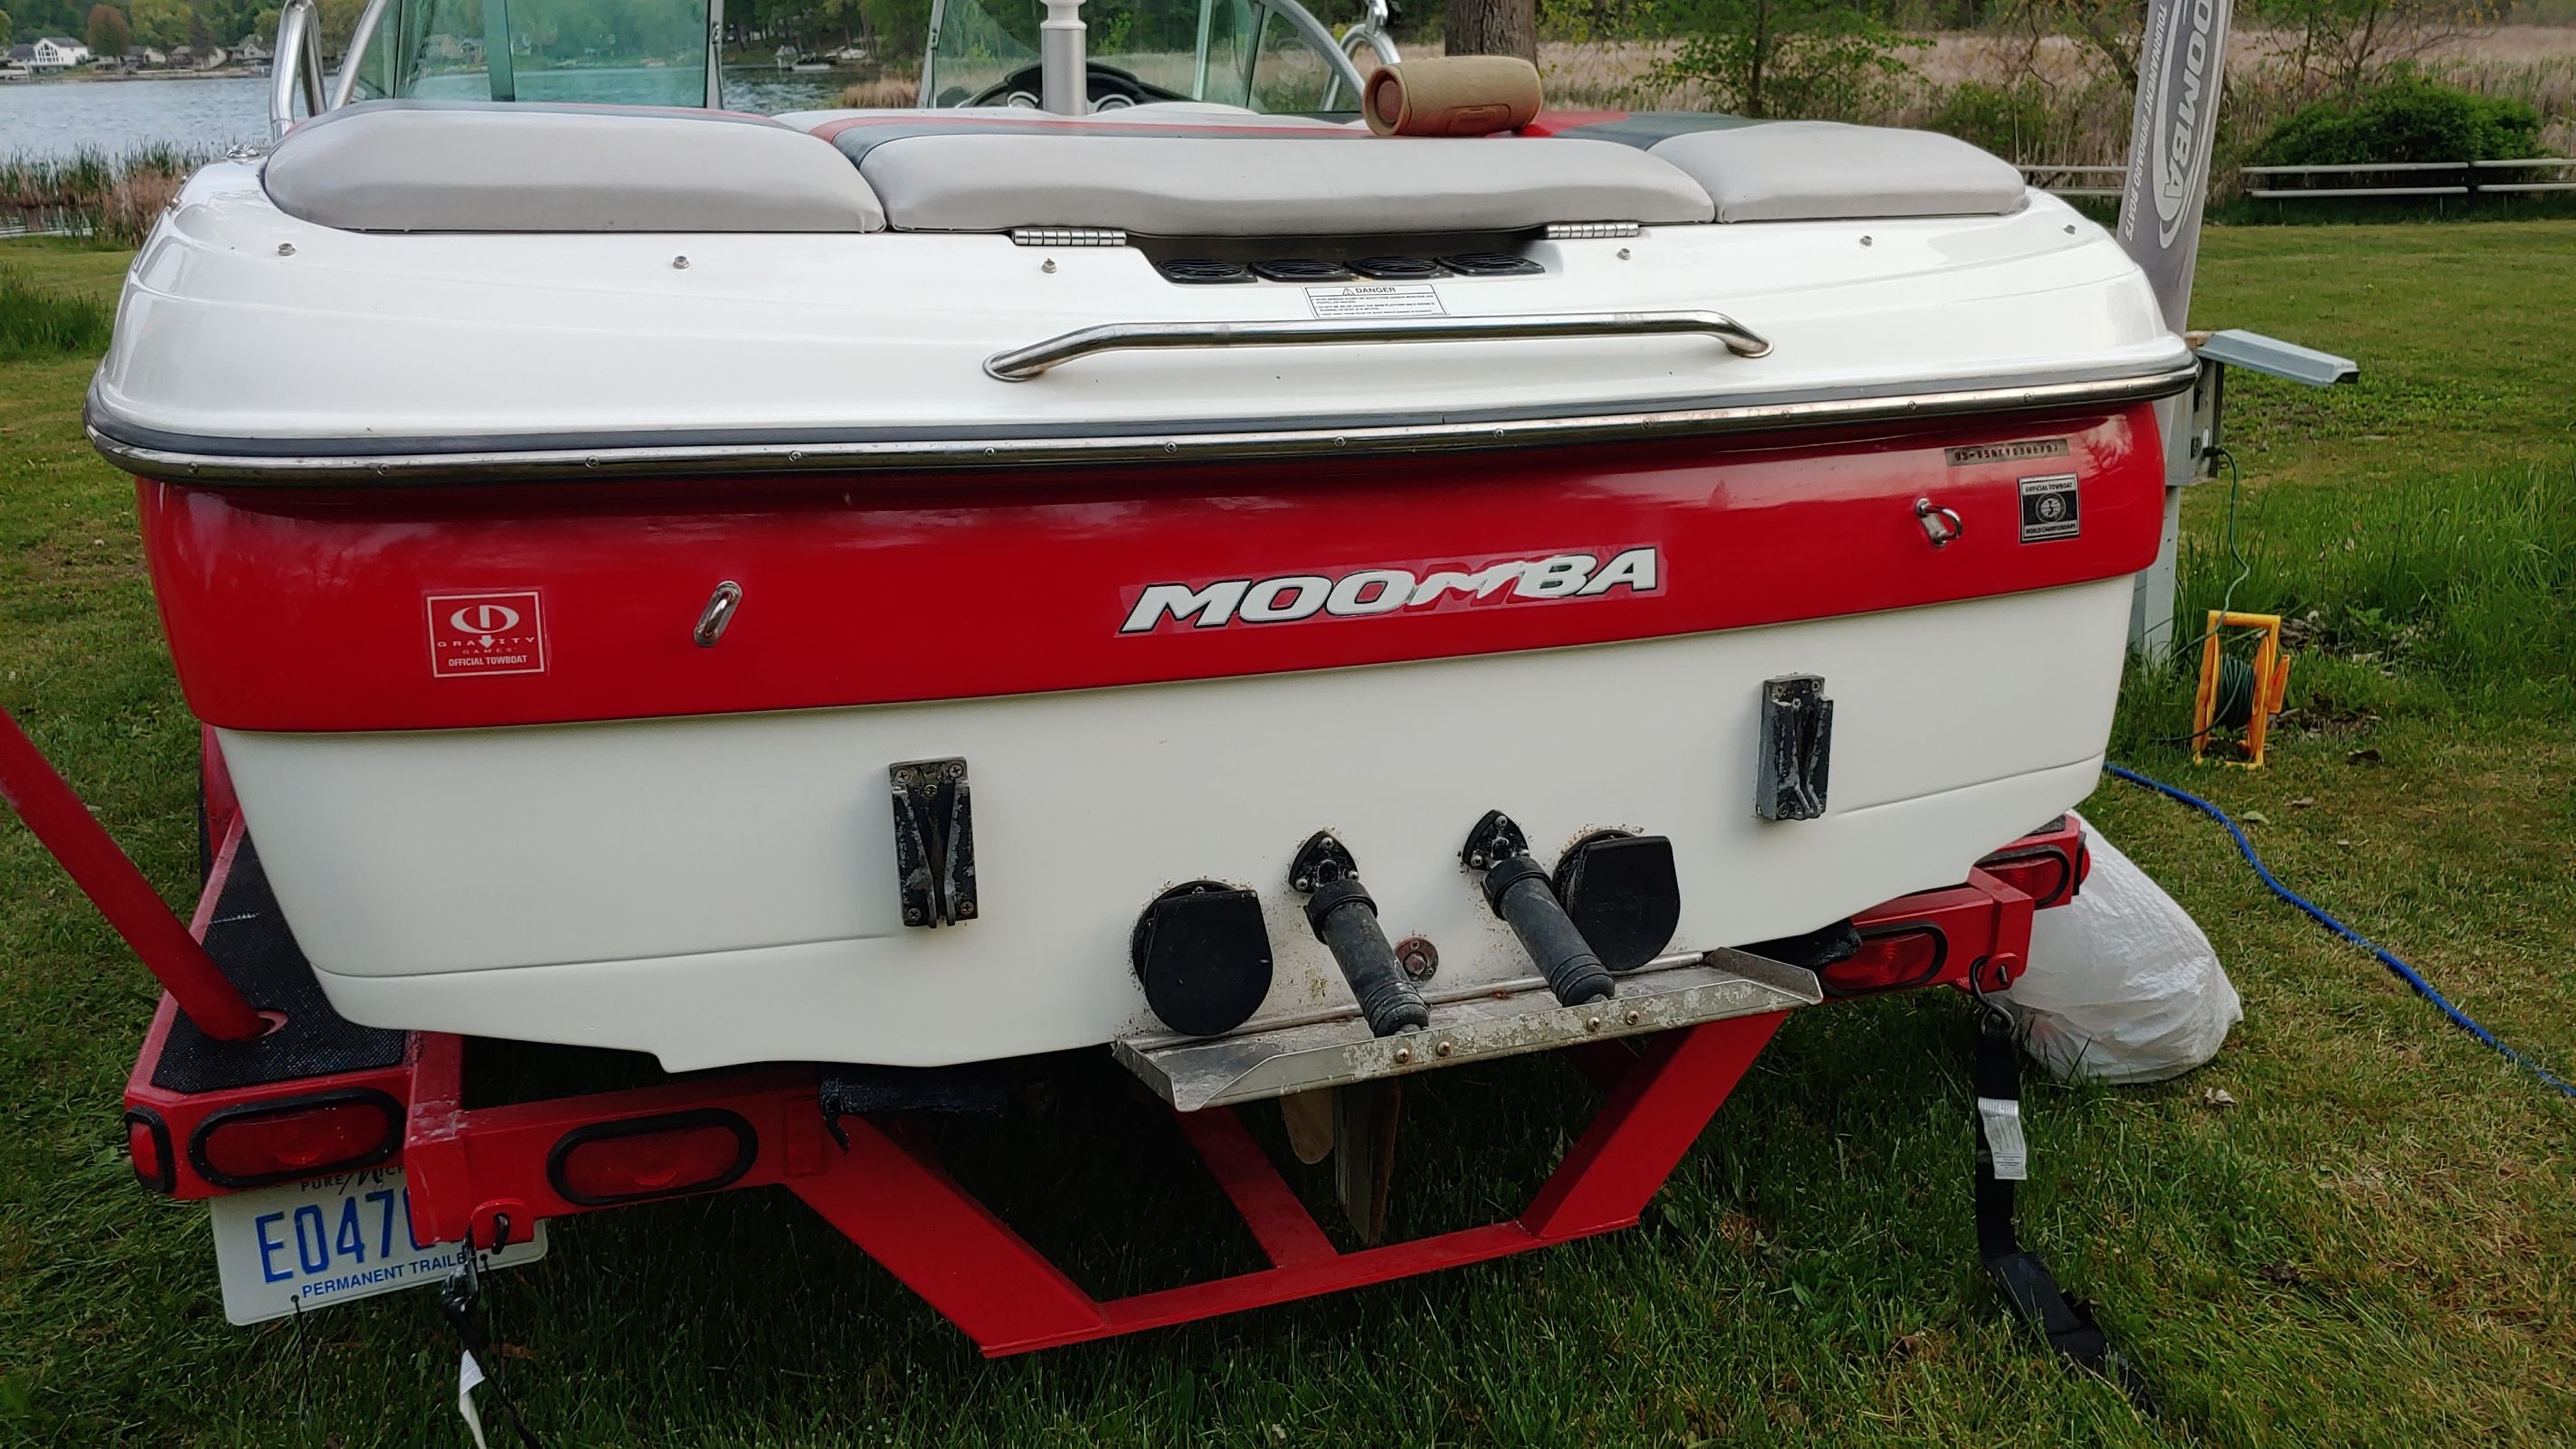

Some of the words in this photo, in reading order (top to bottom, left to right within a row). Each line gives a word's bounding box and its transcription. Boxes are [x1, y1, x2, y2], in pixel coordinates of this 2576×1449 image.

[2142, 3, 2168, 117] TOURNAMENT
[2164, 0, 2213, 198] OOMBA
[2133, 115, 2151, 188] INBOARD
[2125, 190, 2140, 242] BOATS
[2025, 485, 2049, 493] OFFICIAL
[2049, 482, 2073, 490] TOWBOAT
[1119, 546, 1658, 635] MOOMBA
[448, 657, 484, 667] OFFICIAL
[485, 655, 527, 665] TOWBOAT
[301, 1176, 345, 1192] PURE
[302, 1266, 405, 1299] PERMANENT
[408, 1252, 466, 1274] TRAILE
